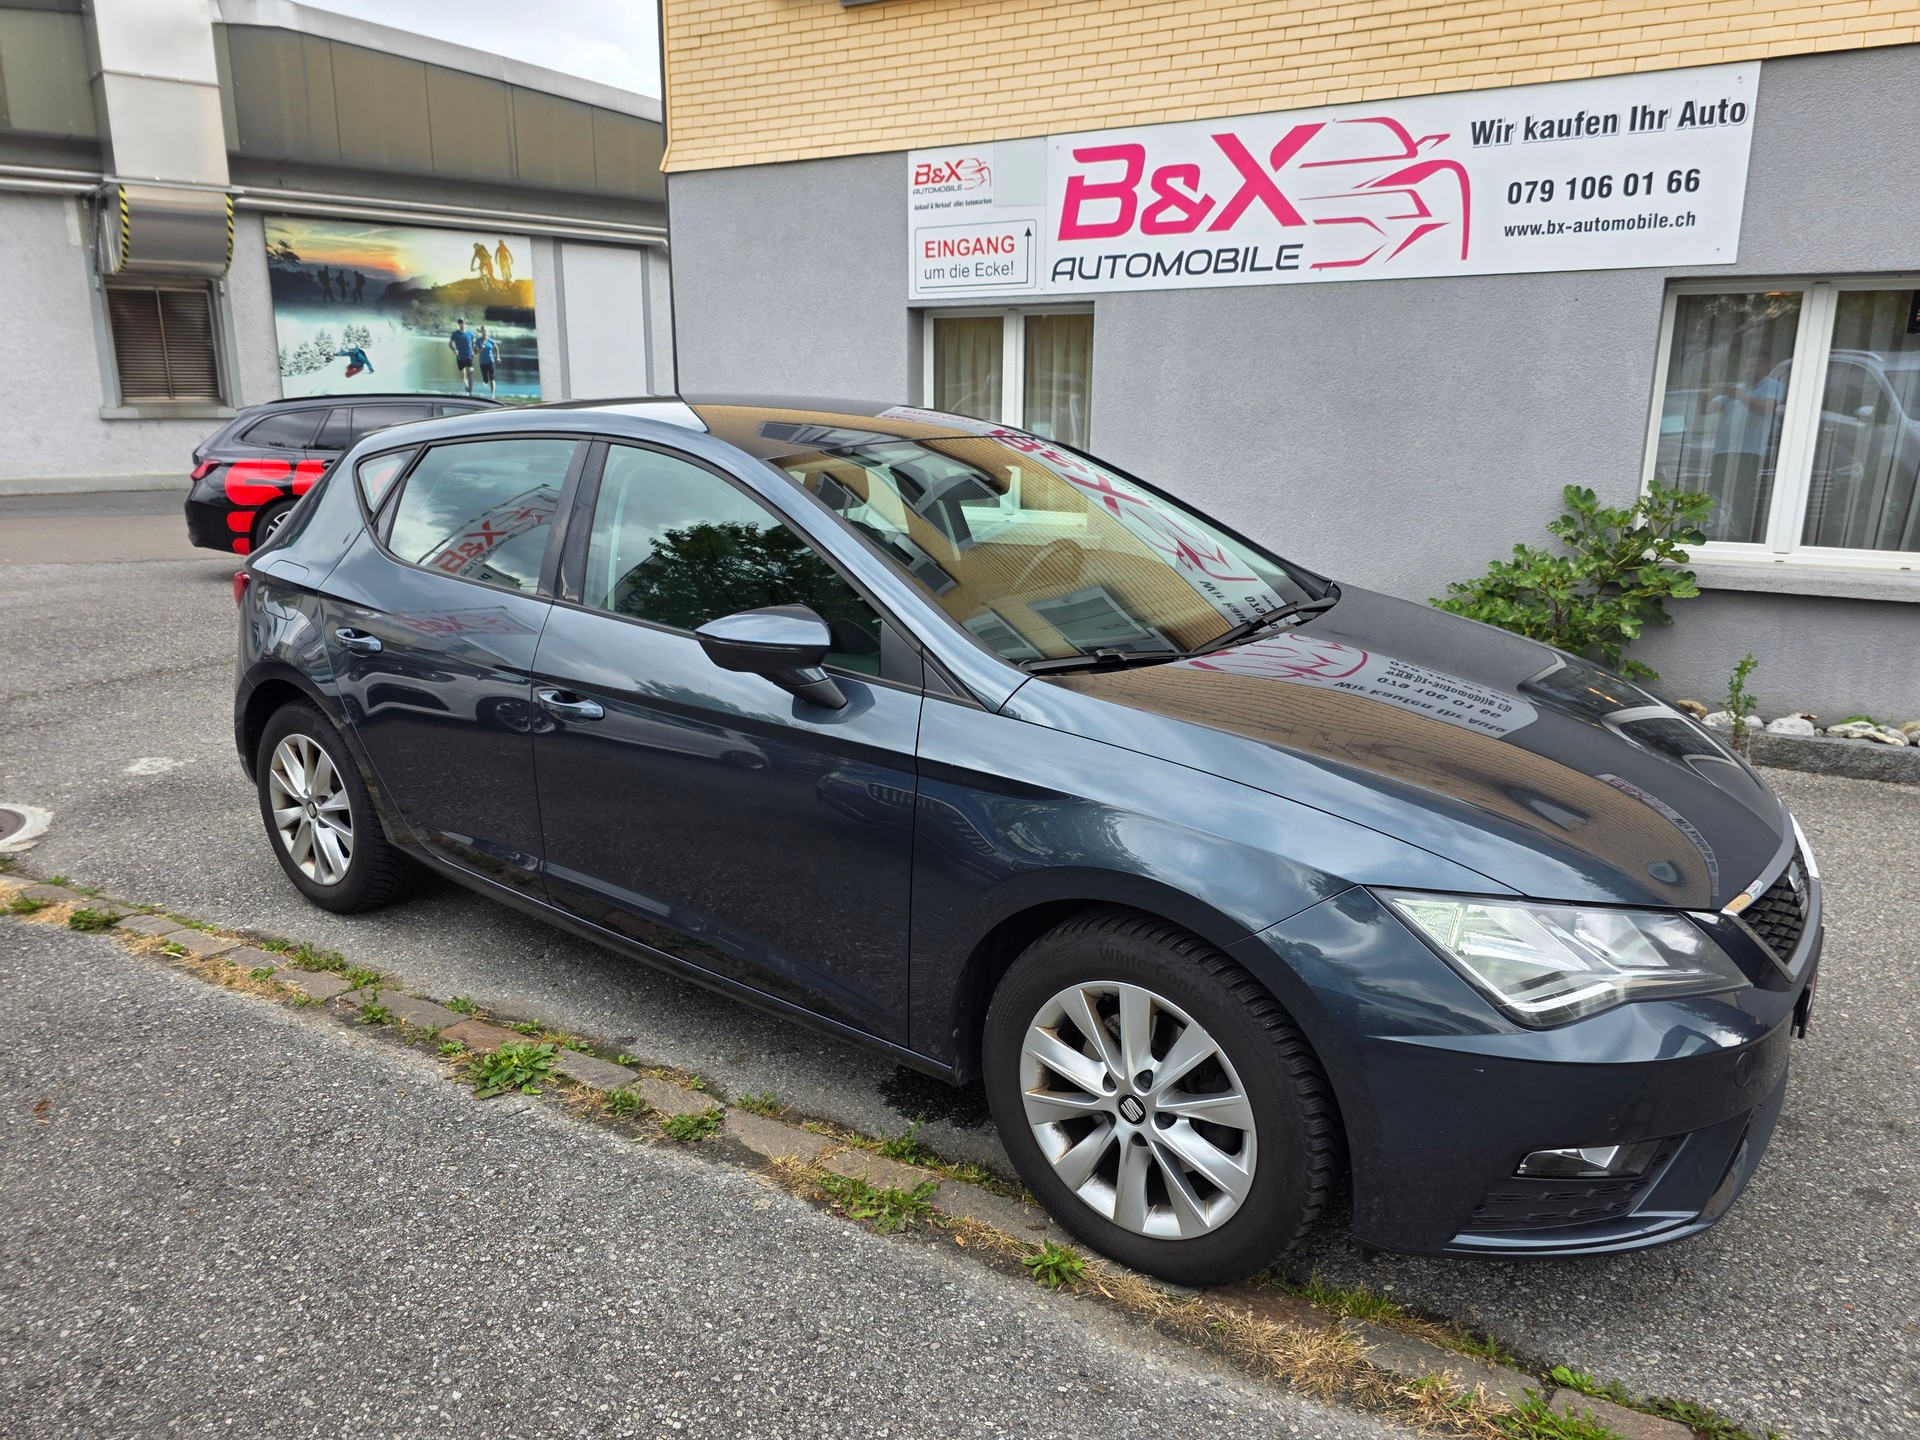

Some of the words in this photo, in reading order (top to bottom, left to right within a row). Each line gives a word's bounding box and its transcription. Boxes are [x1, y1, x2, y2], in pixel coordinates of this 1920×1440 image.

[1471, 118, 1516, 147] Wir
[1523, 109, 1618, 142] kaufen
[1629, 103, 1669, 133] Ihr
[1677, 98, 1747, 127] Auto
[913, 159, 966, 186] B&X
[1057, 122, 1328, 241] B&X
[912, 183, 963, 196] AUTOMOBILE
[1507, 179, 1556, 205] 079
[1565, 174, 1613, 201] 106
[1622, 171, 1656, 197] 01
[1666, 168, 1701, 194] 66
[1504, 211, 1697, 238] www.bx-automobile.ch
[924, 235, 1016, 259] EINGANG
[924, 267, 945, 280] um
[949, 263, 970, 279] die
[975, 260, 1014, 278] Ecke!
[1051, 243, 1304, 283] AUTOMOBILE
